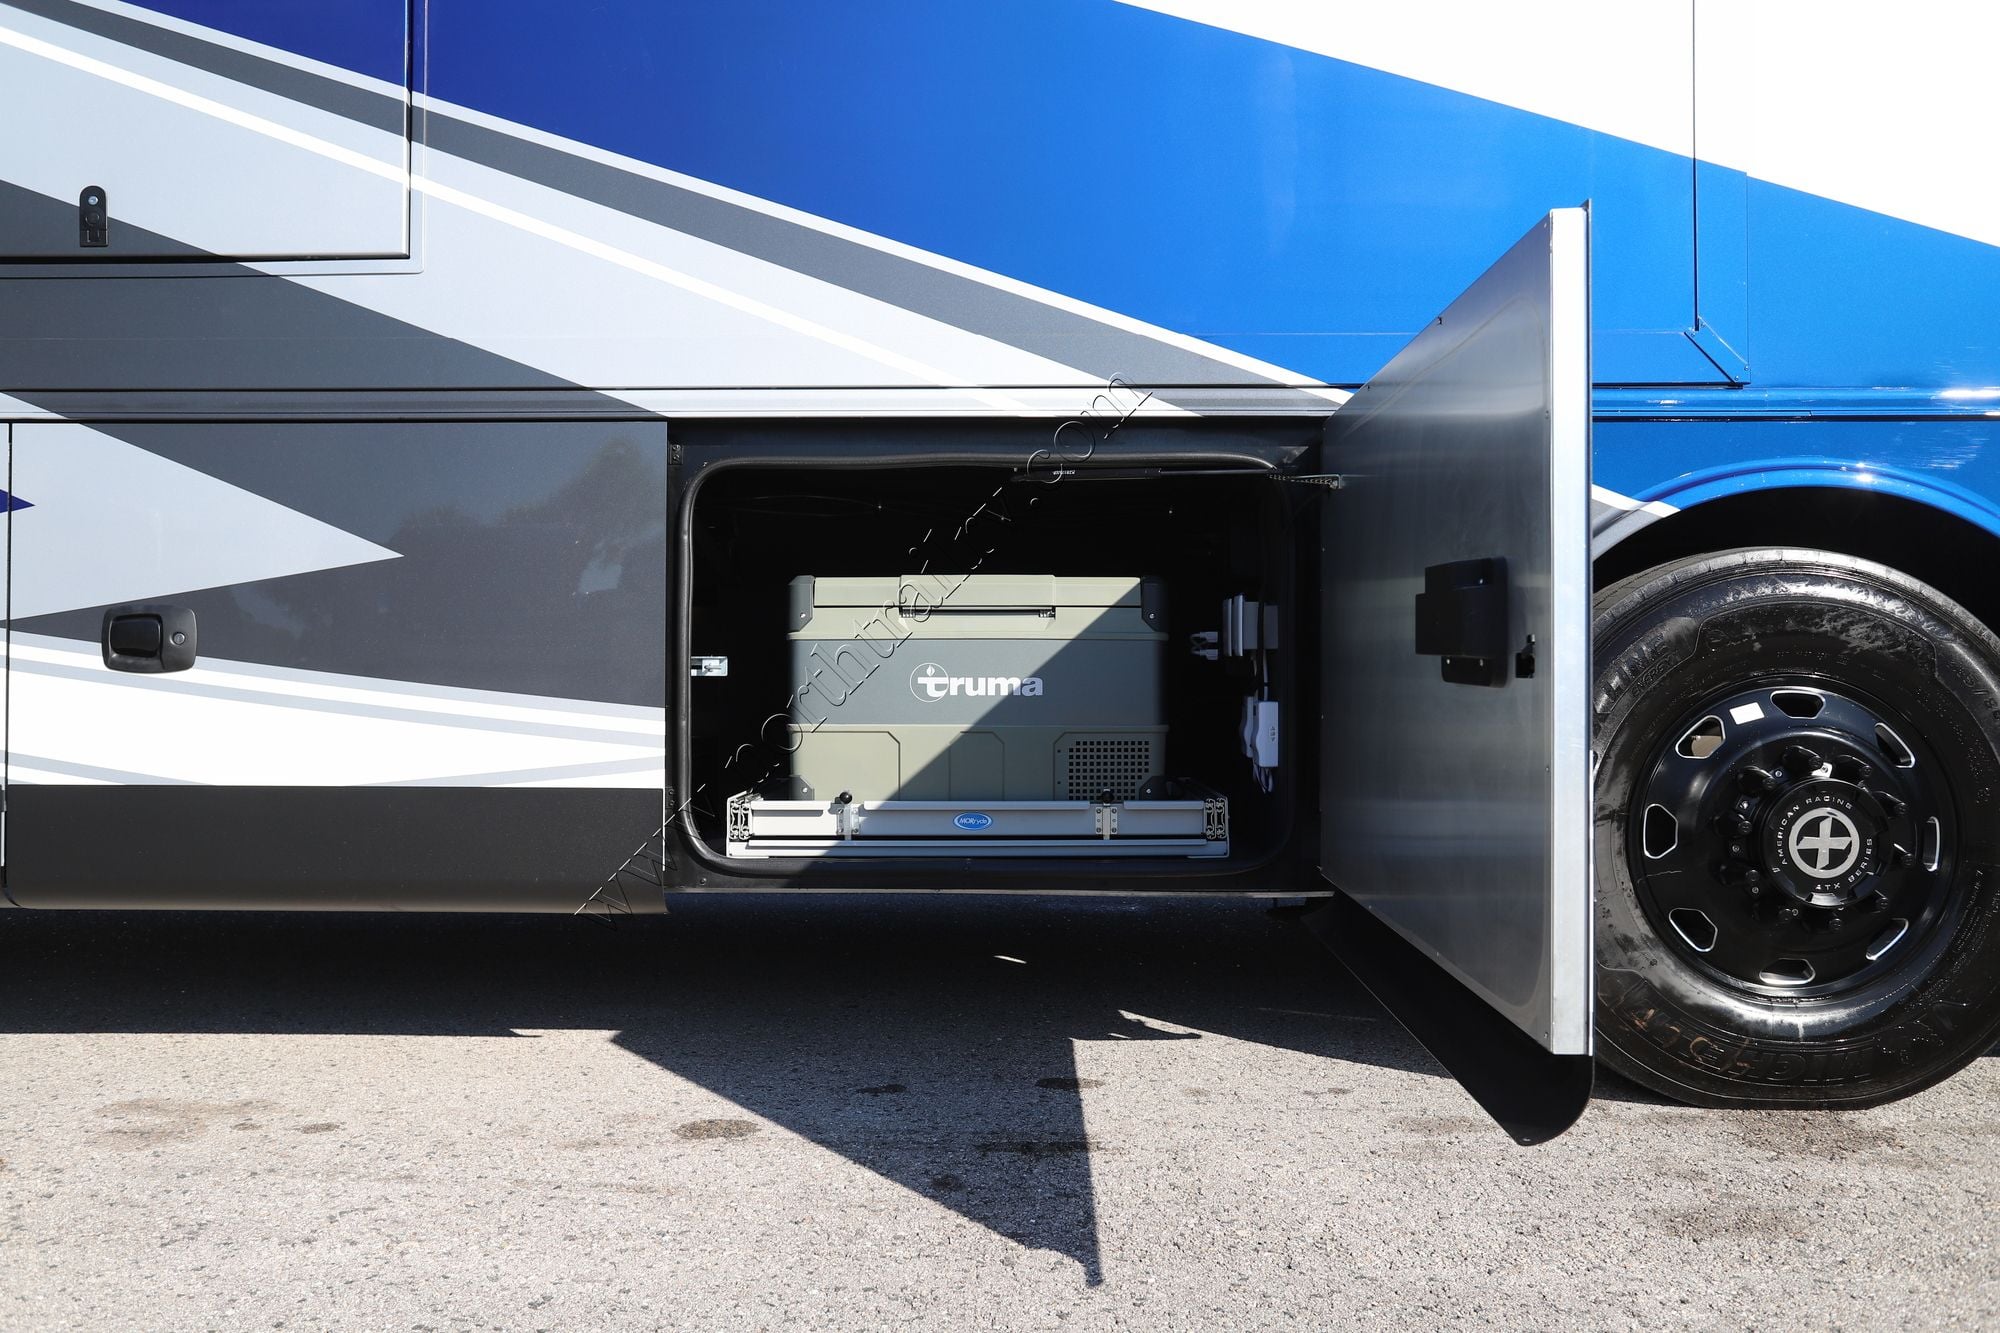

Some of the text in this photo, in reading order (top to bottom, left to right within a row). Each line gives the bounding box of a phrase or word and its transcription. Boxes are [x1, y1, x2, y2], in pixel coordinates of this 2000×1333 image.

[911, 668, 1044, 699] truma
[1777, 795, 1853, 865] AMERICAN RACING
[1815, 838, 1873, 890] ATX SERIES
